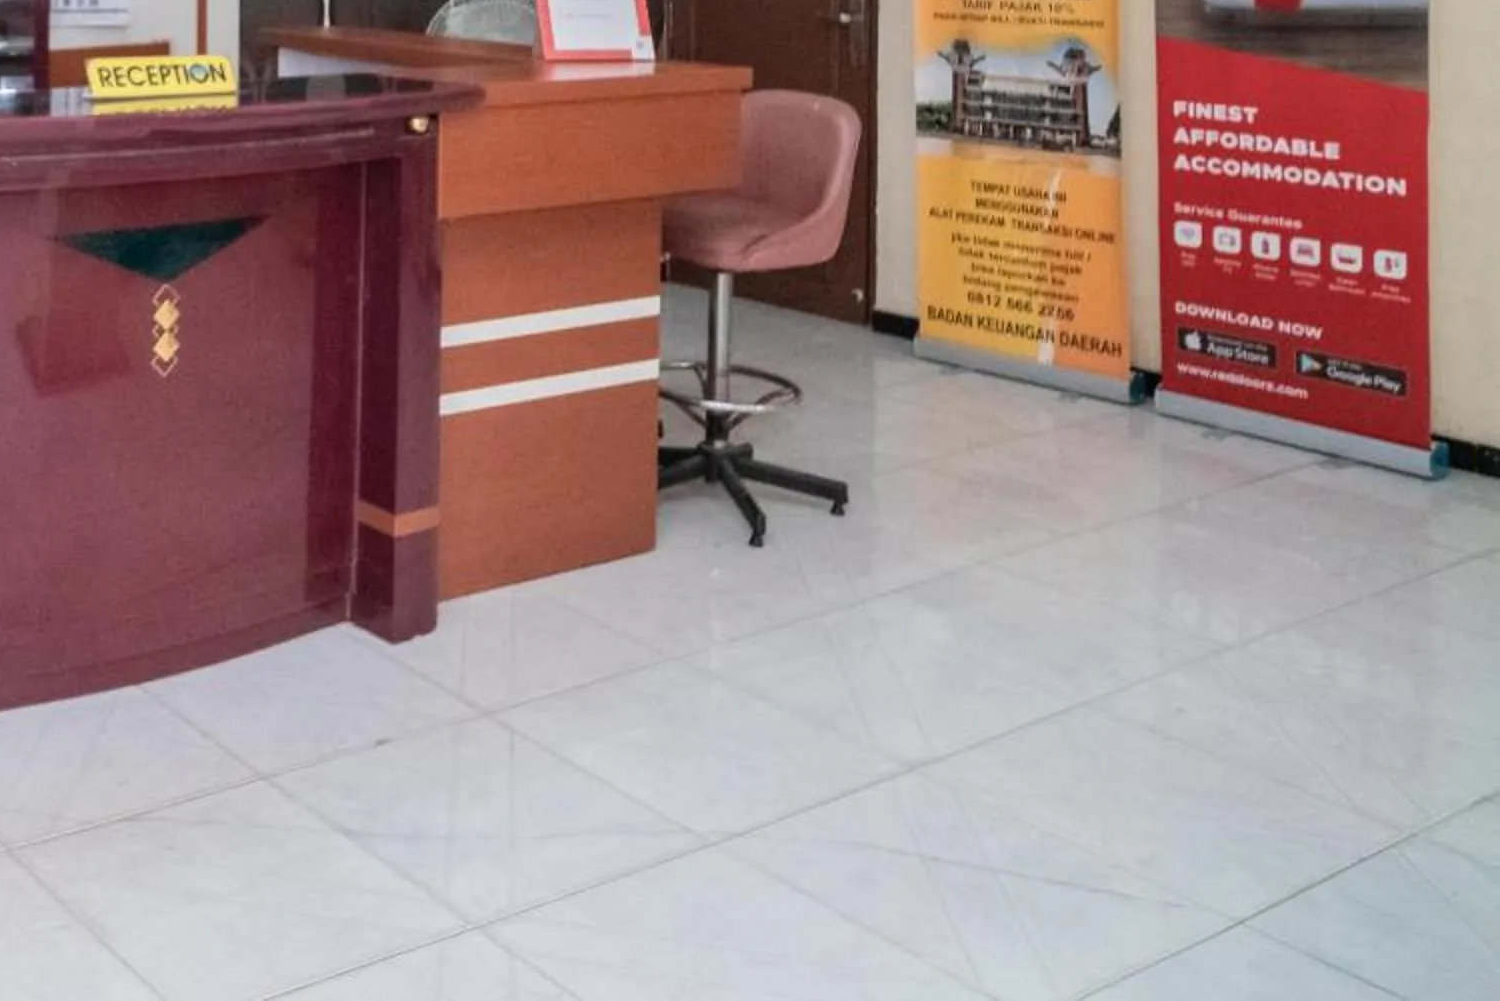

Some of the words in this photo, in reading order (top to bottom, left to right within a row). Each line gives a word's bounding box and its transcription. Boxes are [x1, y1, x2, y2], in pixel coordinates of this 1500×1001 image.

[1000, 0, 1043, 12] PAJAK
[97, 62, 228, 88] RECEPTION
[1173, 100, 1258, 124] FINEST
[1173, 127, 1341, 160] AFFORDABLE
[1173, 153, 1407, 197] ACCOMMODATION
[970, 181, 1011, 196] TEMPAT
[1013, 185, 1050, 201] USAHA
[975, 198, 1060, 219] MENGGUNAKAN
[1173, 202, 1224, 219] Service
[929, 206, 953, 220] ALAT
[955, 210, 1005, 227] PEREKAM
[1011, 218, 1073, 237] TRANSAKSI
[1074, 229, 1116, 245] ONLINE
[927, 305, 974, 329] BADAN
[976, 314, 1056, 344] KEUANGAN
[1059, 330, 1123, 358] DAERAH
[1175, 301, 1274, 331] DOWNLOAD
[1278, 315, 1323, 340] NOW
[1207, 342, 1233, 361] App
[1236, 345, 1270, 365] Store
[1326, 365, 1371, 387] Google
[1374, 375, 1402, 394] Play
